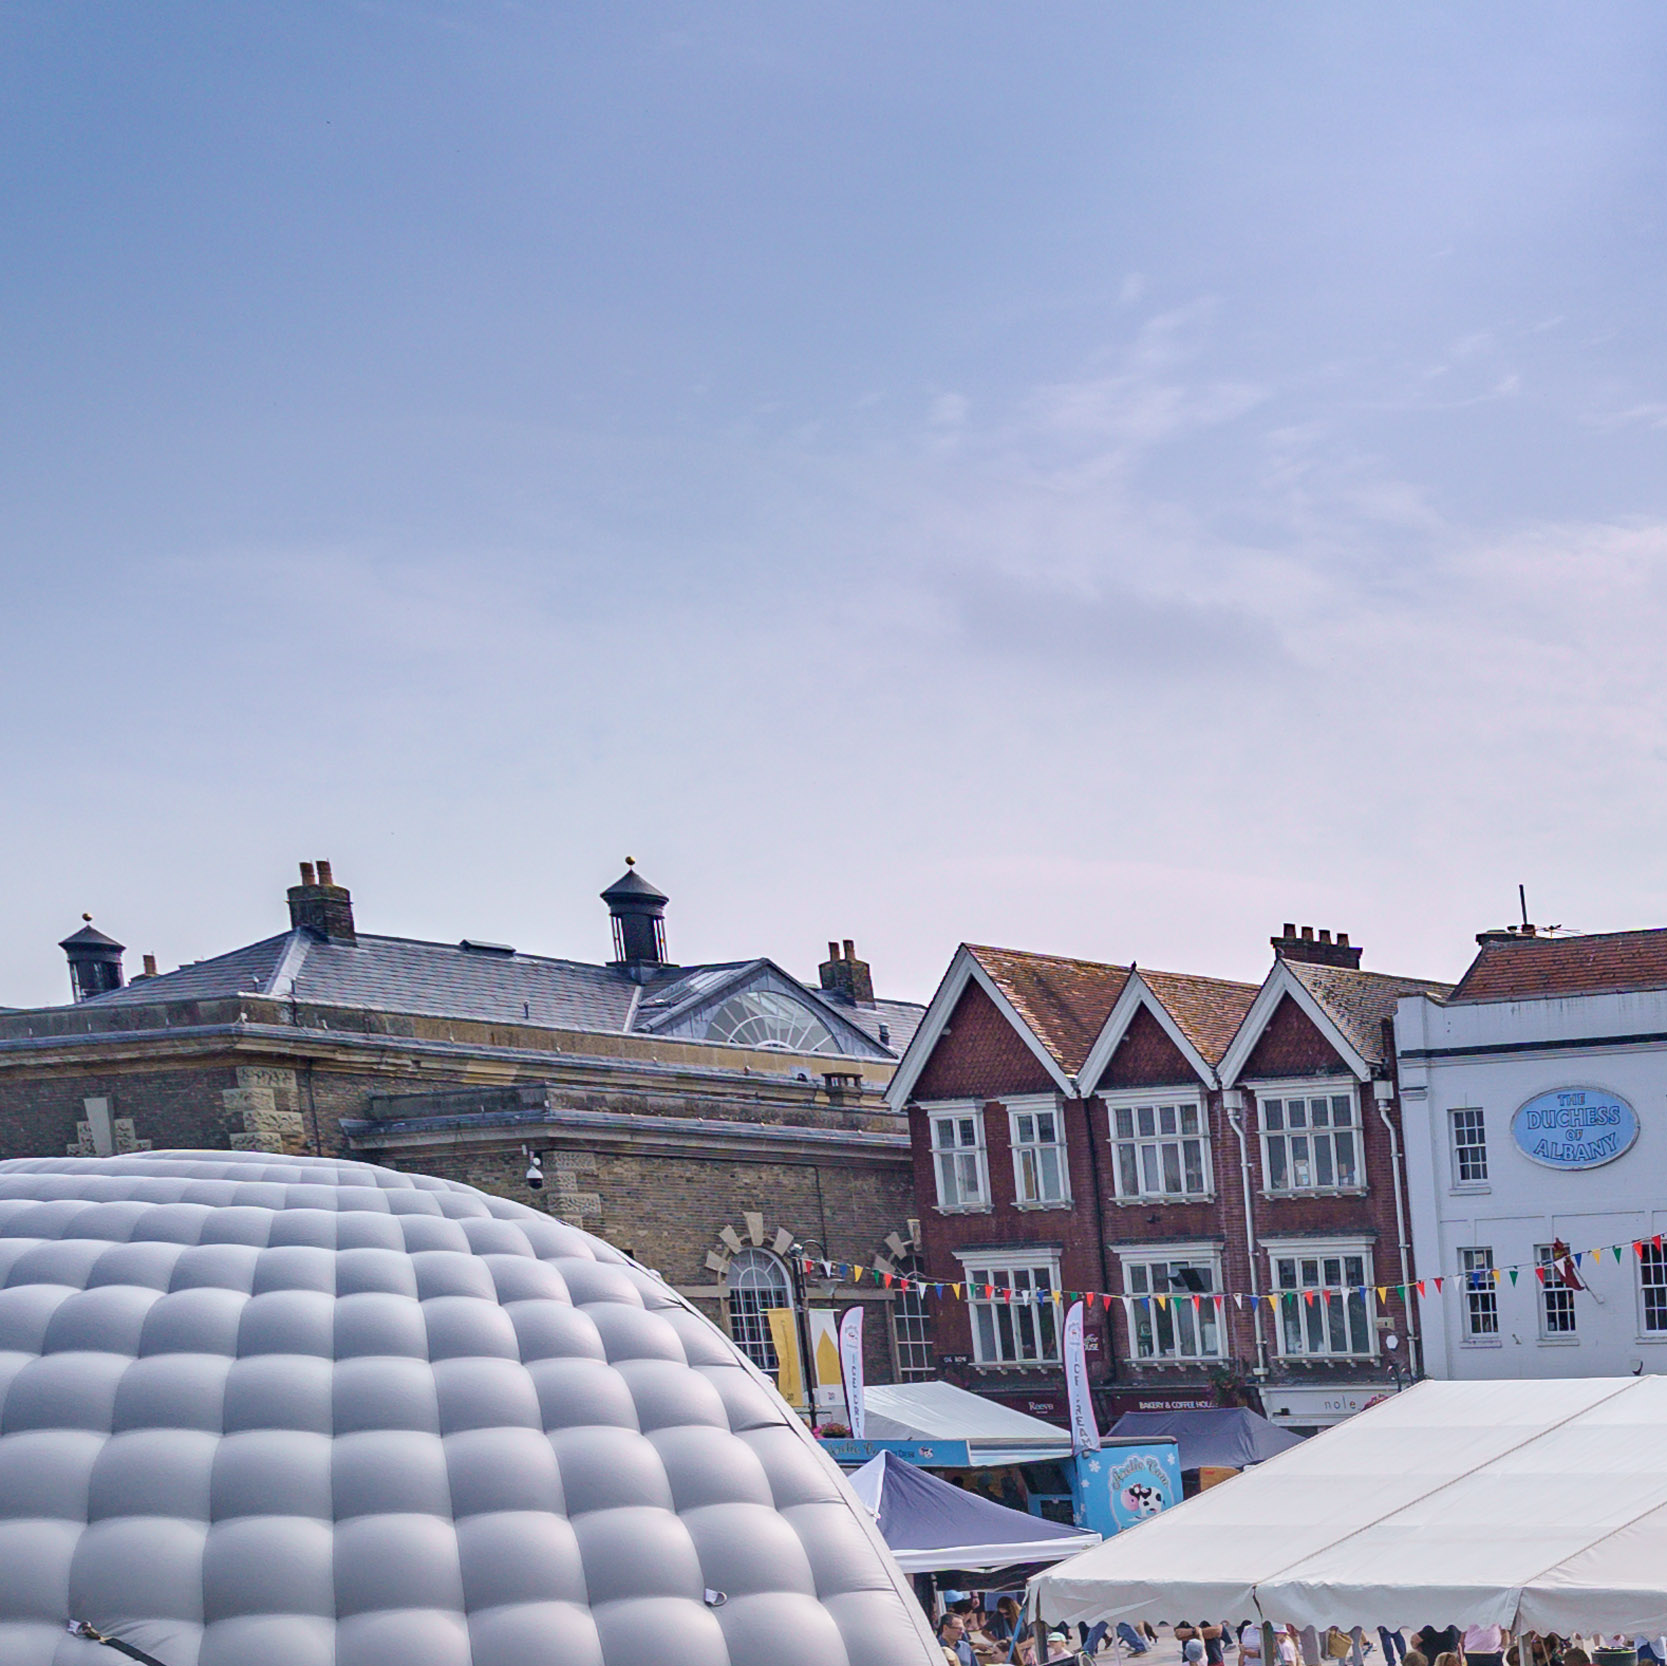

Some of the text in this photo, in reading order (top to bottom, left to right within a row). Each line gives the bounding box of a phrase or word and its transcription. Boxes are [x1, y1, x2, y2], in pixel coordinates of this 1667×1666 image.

[1557, 1093, 1585, 1106] THE
[1527, 1106, 1620, 1130] DUCHESS
[1533, 1132, 1616, 1161] ALBANY
[1565, 1129, 1583, 1141] OF
[1075, 1394, 1092, 1448] REAM
